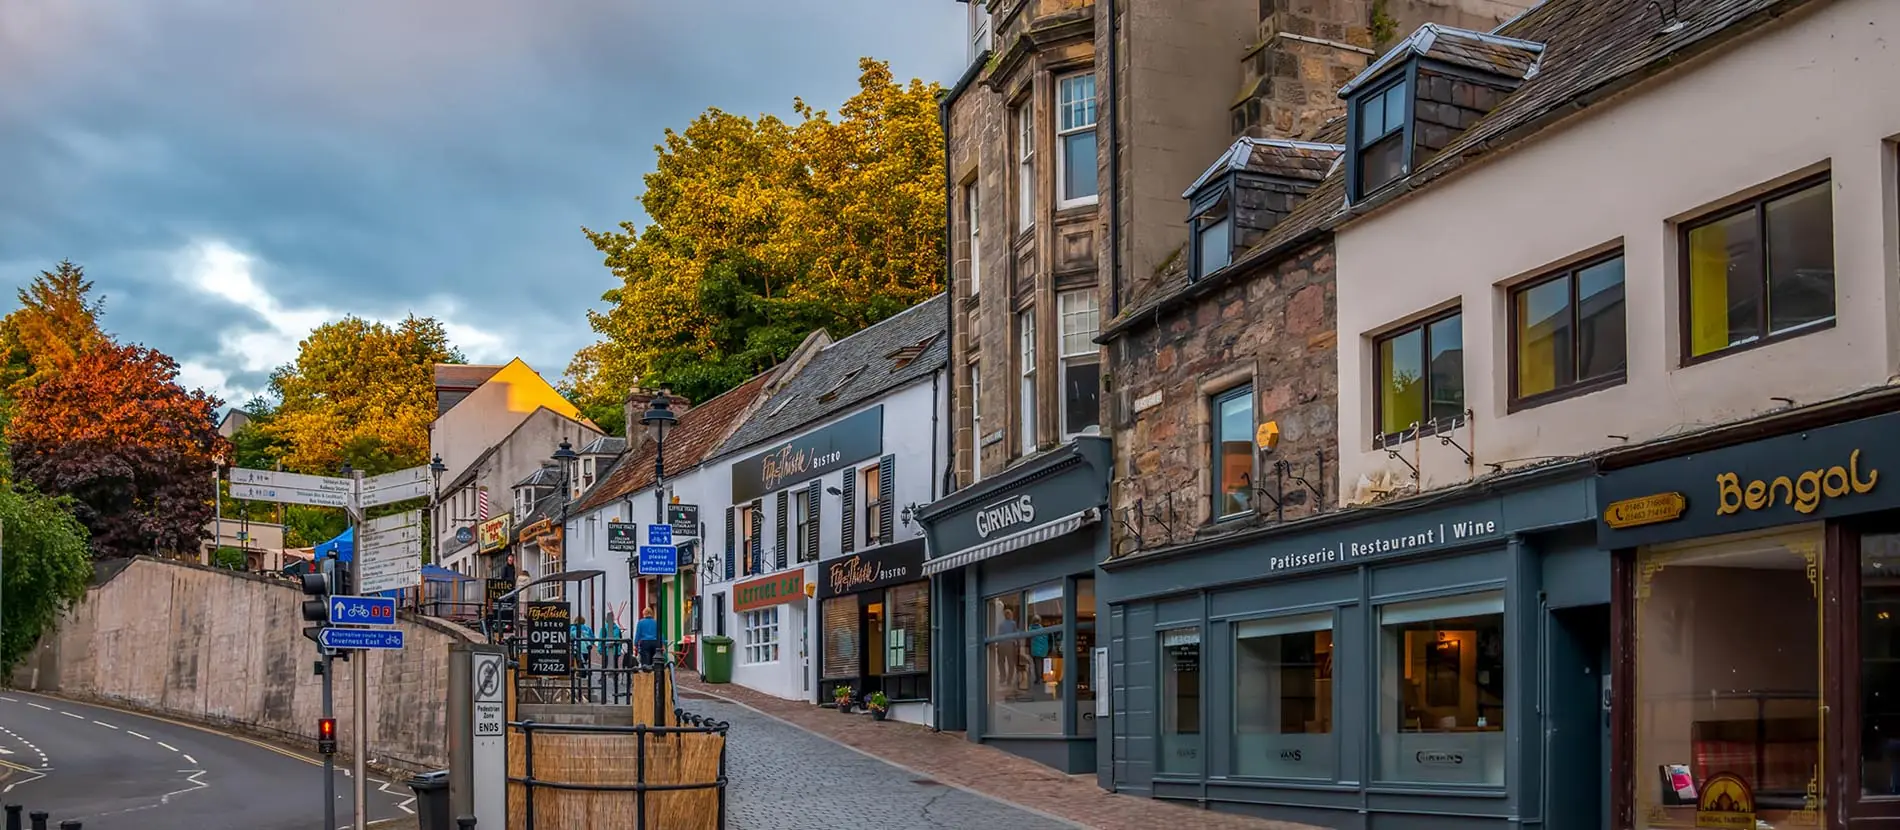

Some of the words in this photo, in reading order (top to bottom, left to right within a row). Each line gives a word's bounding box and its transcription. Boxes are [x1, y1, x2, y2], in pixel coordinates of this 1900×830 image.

[813, 451, 841, 468] BISTRO
[1716, 449, 1878, 516] Bengal
[976, 495, 1035, 538] GIRVANS
[1270, 547, 1335, 570] Patisserie
[1351, 529, 1434, 557] Restaurant
[1453, 520, 1495, 539] Wine
[880, 566, 907, 580] BISTRO
[488, 579, 513, 590] Little
[737, 582, 777, 605] LETTUCE
[531, 631, 567, 643] OPEN
[532, 663, 565, 672] 712422
[479, 722, 499, 732] ENDS
